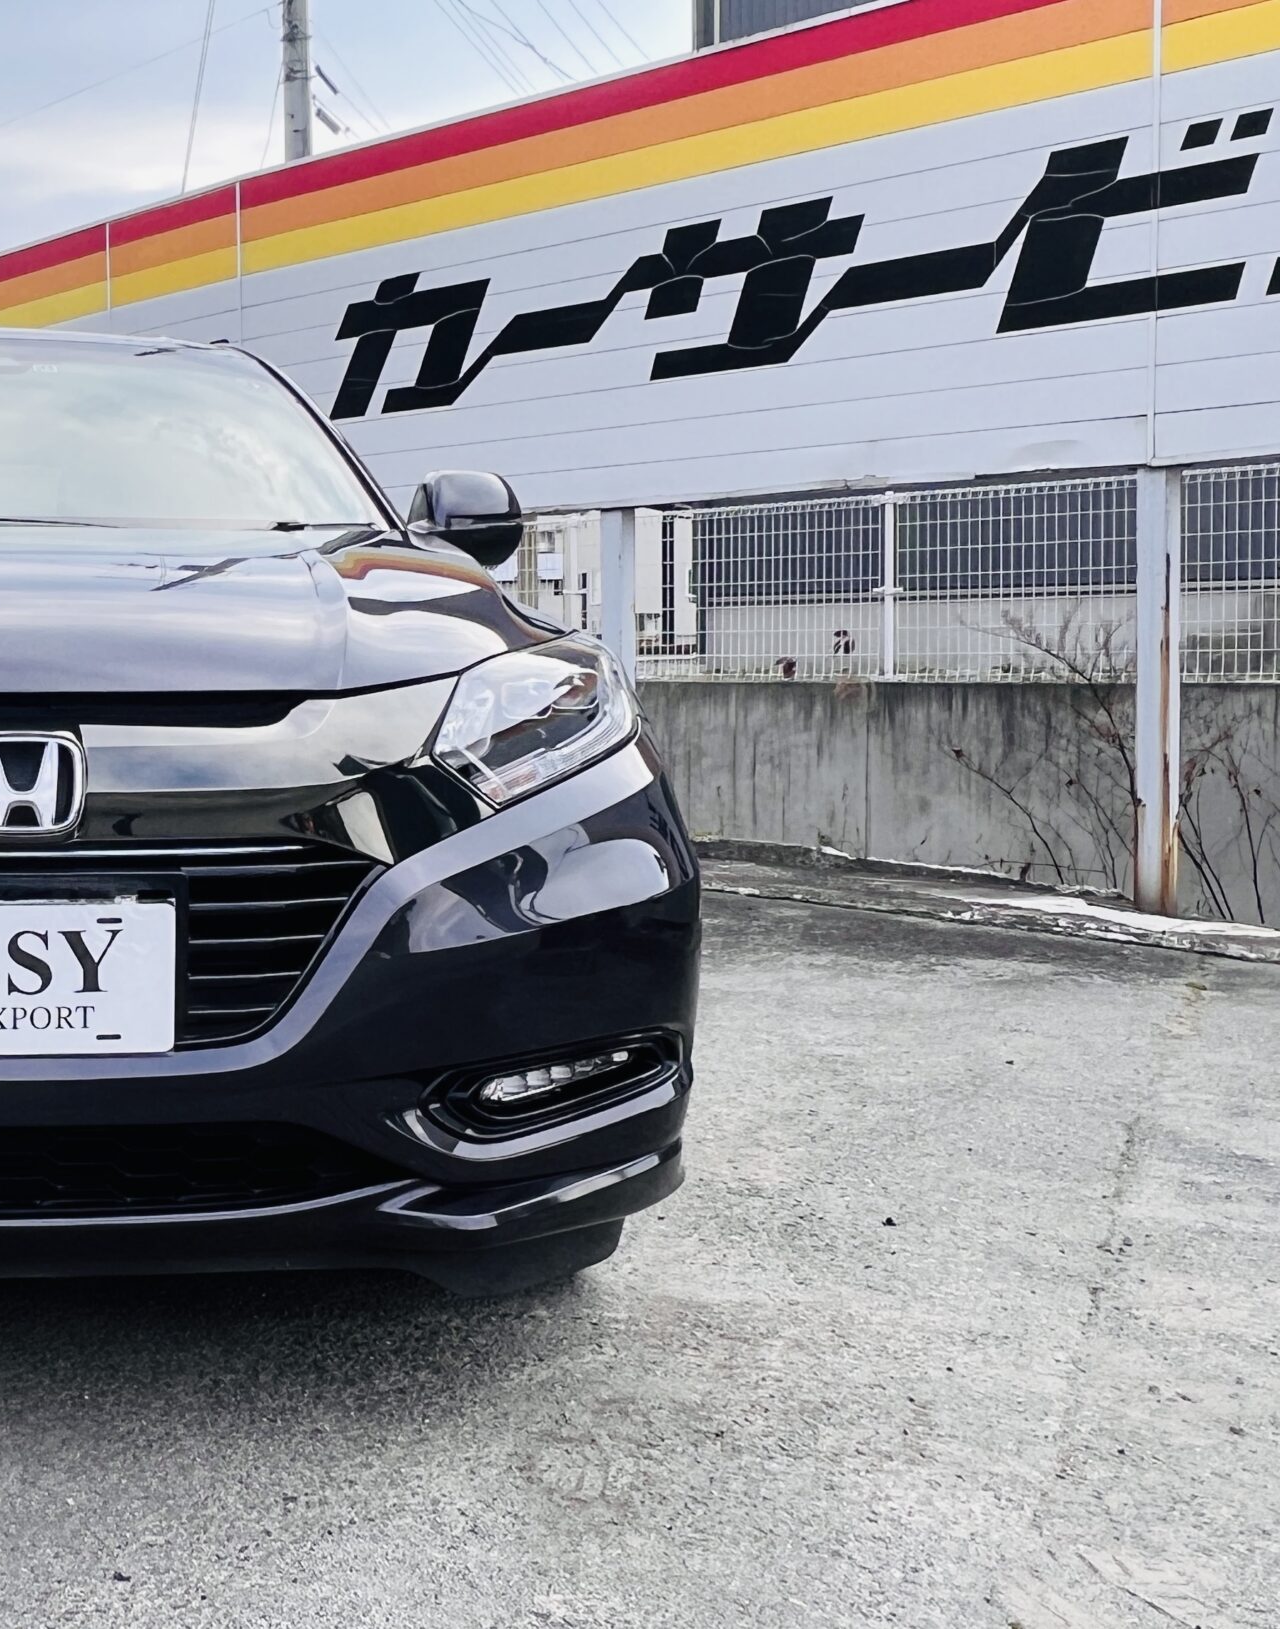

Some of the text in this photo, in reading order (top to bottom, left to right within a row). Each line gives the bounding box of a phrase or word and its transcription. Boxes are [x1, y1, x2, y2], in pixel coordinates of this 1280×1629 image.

[329, 107, 1280, 420] カーサービ
